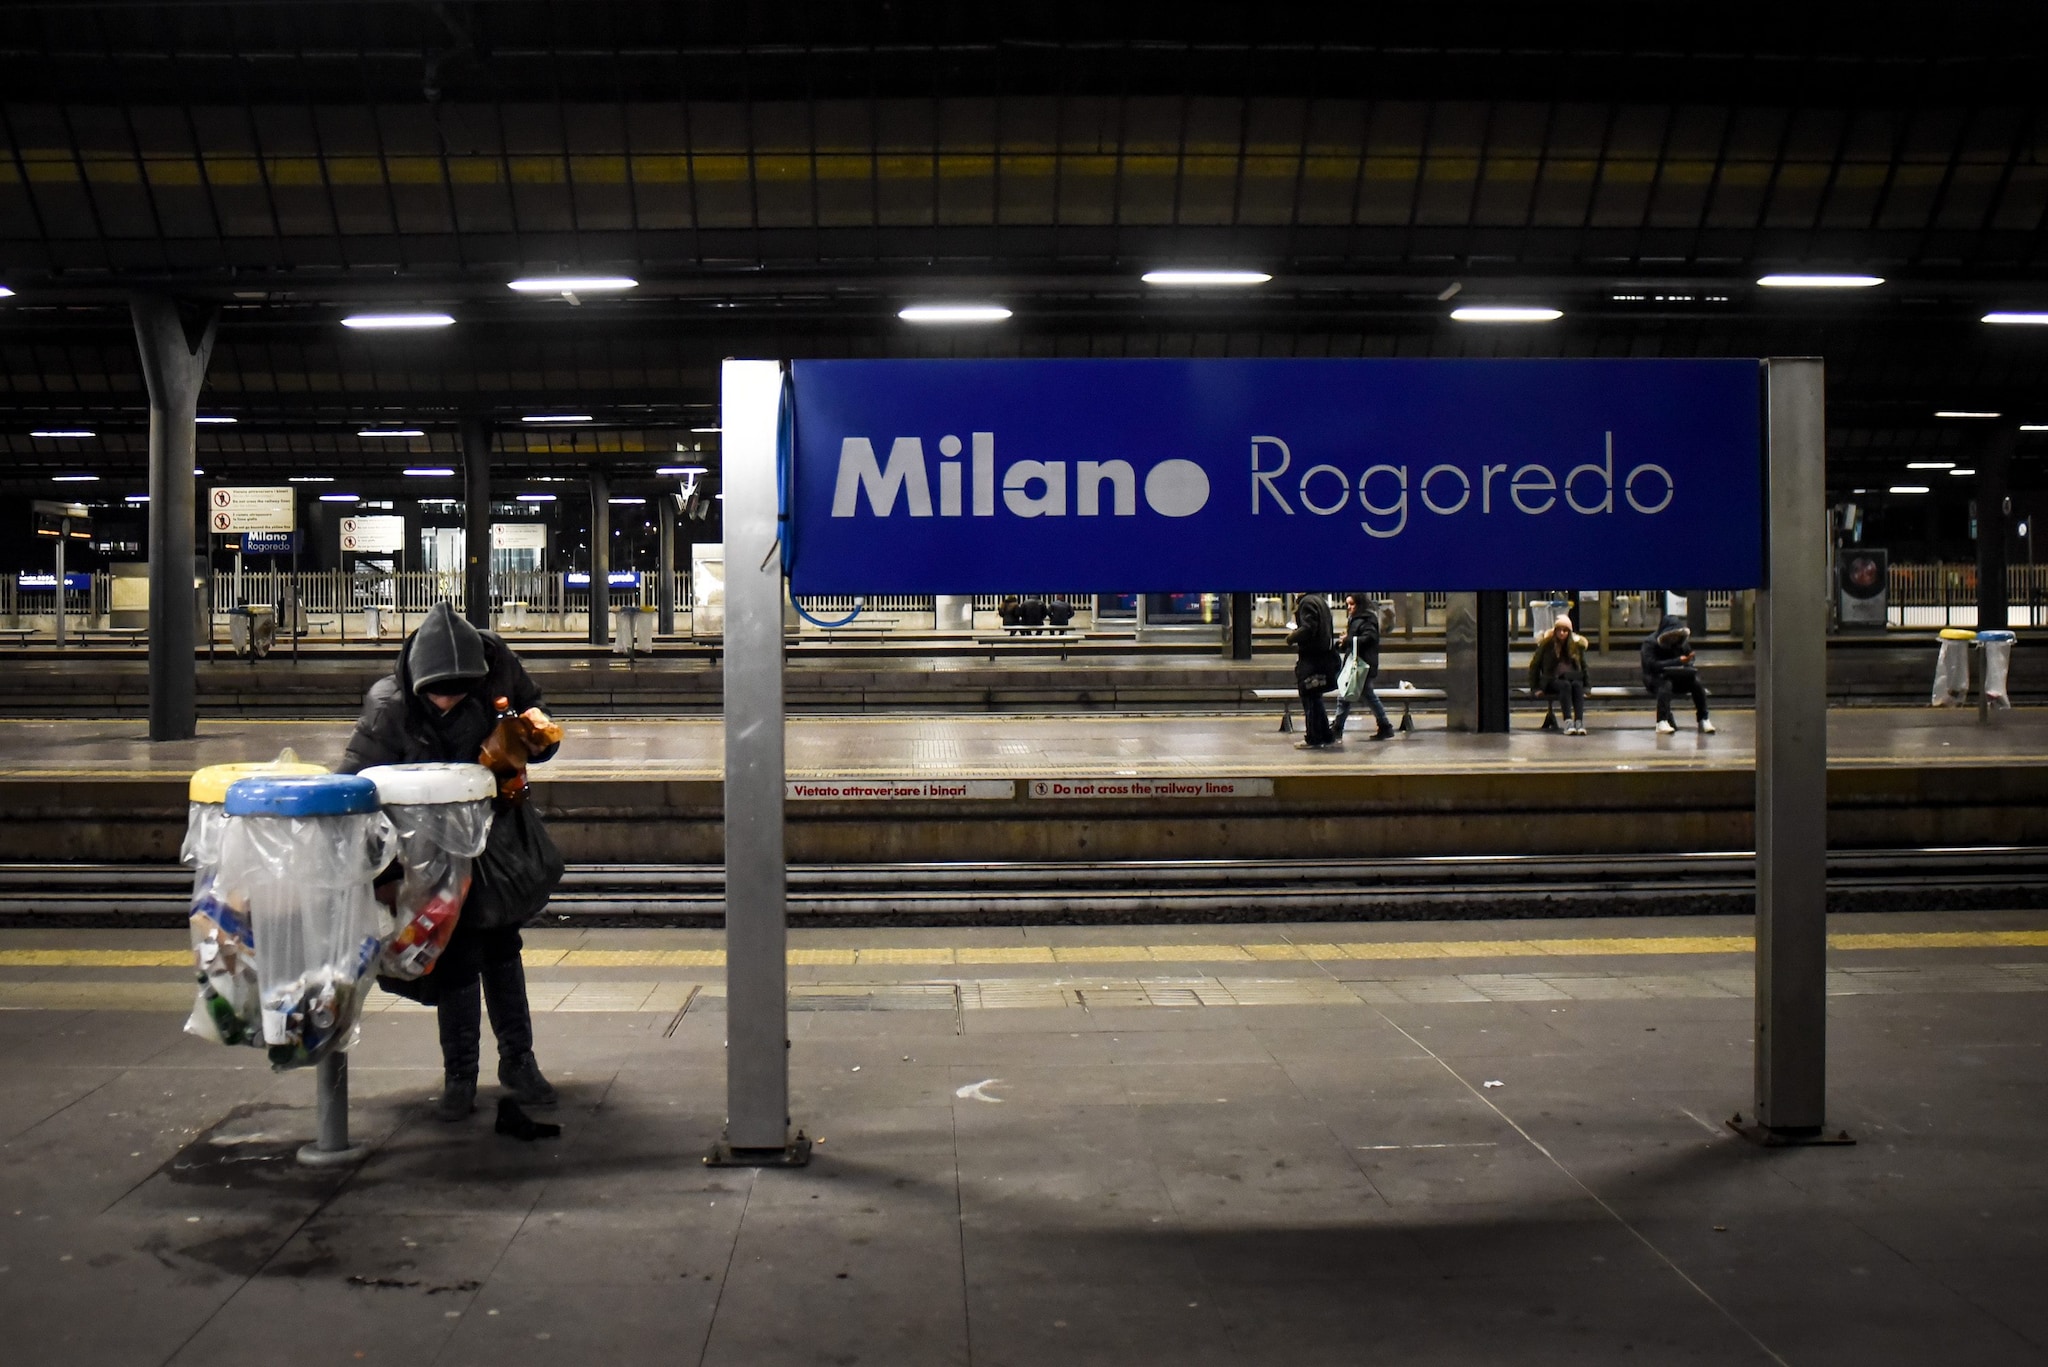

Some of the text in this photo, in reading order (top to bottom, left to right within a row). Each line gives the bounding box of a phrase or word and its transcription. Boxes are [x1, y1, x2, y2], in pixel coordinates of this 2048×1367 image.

[832, 432, 1674, 538] Milano Rogoredo
[248, 531, 288, 541] Milano
[247, 541, 290, 553] Rogoredo
[794, 784, 967, 797] Vietato attraversare i binari
[1053, 782, 1234, 796] Do not cross the railway lines
